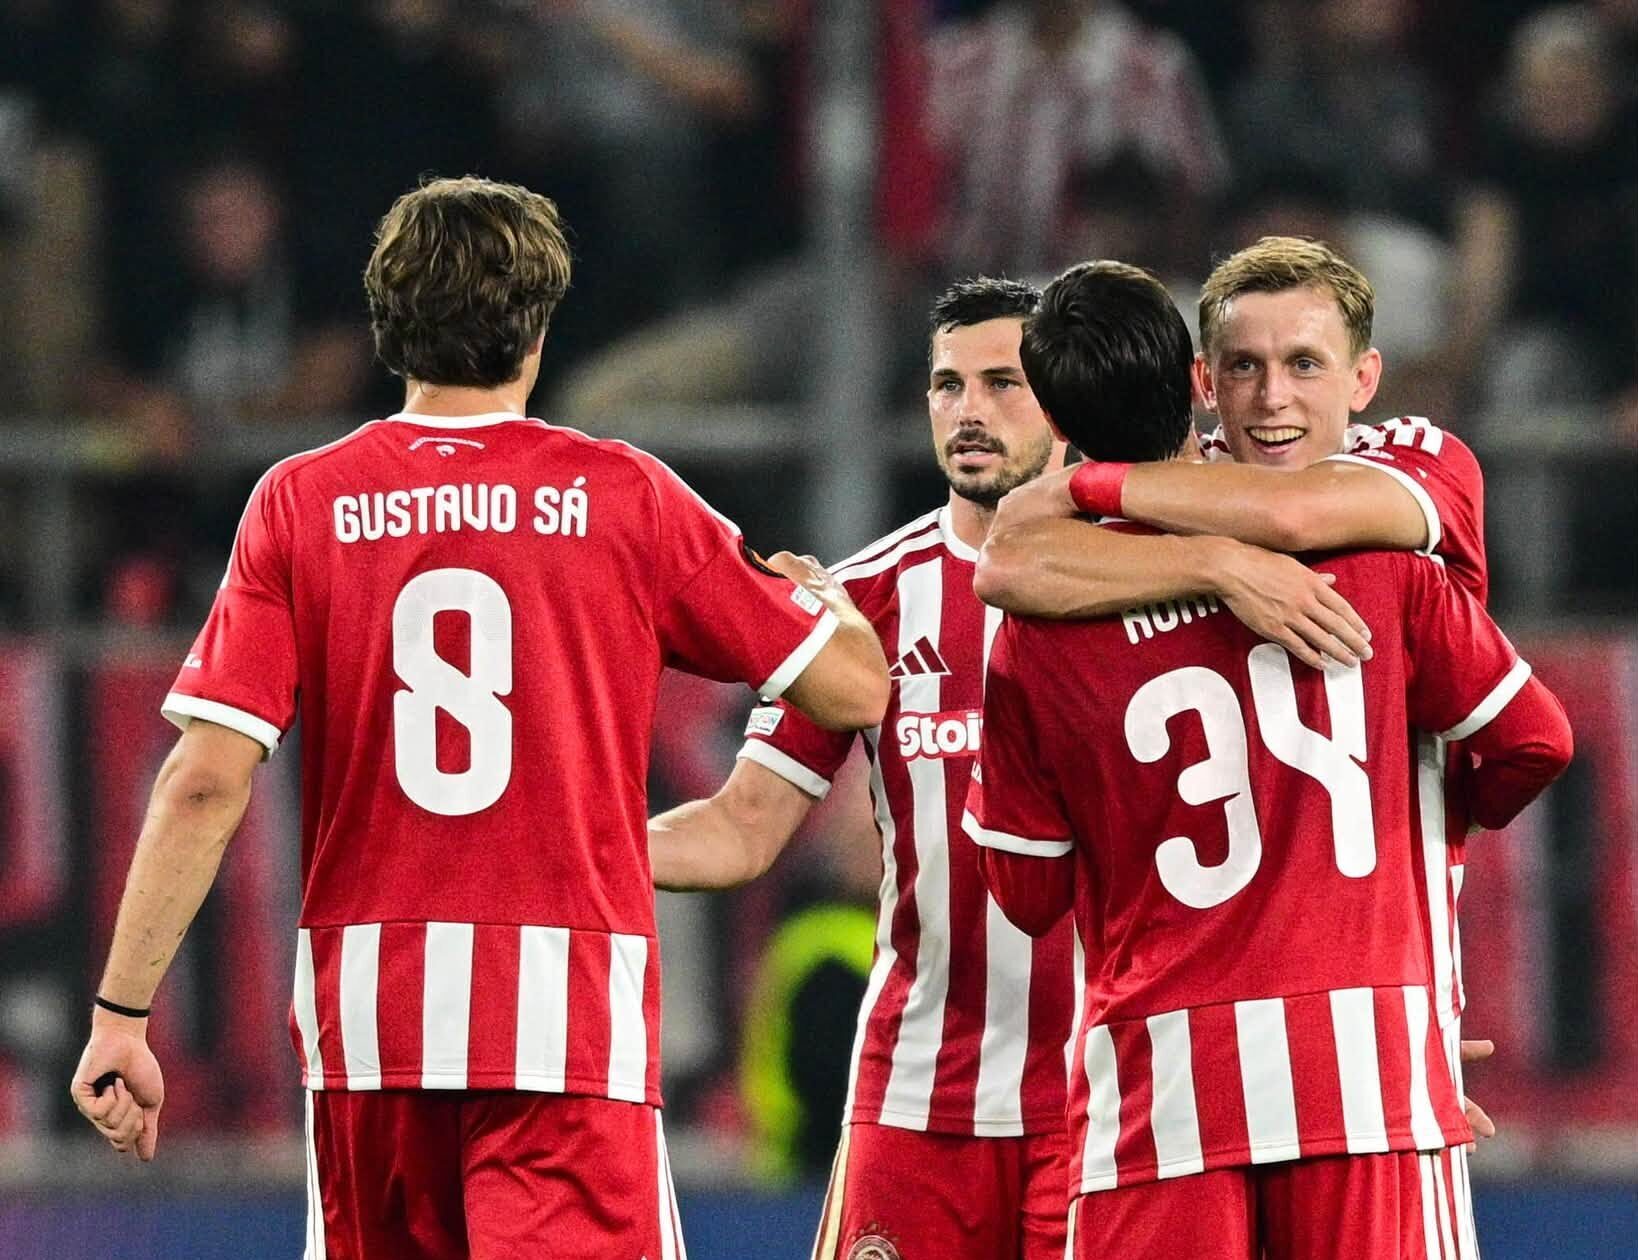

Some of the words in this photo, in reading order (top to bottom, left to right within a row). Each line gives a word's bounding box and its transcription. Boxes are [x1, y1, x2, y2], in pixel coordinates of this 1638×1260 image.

[333, 483, 517, 543] GUSTAVO
[533, 476, 588, 538] SÁ
[392, 567, 513, 816] 8
[896, 711, 984, 757] Stoi
[1124, 642, 1377, 909] 34
